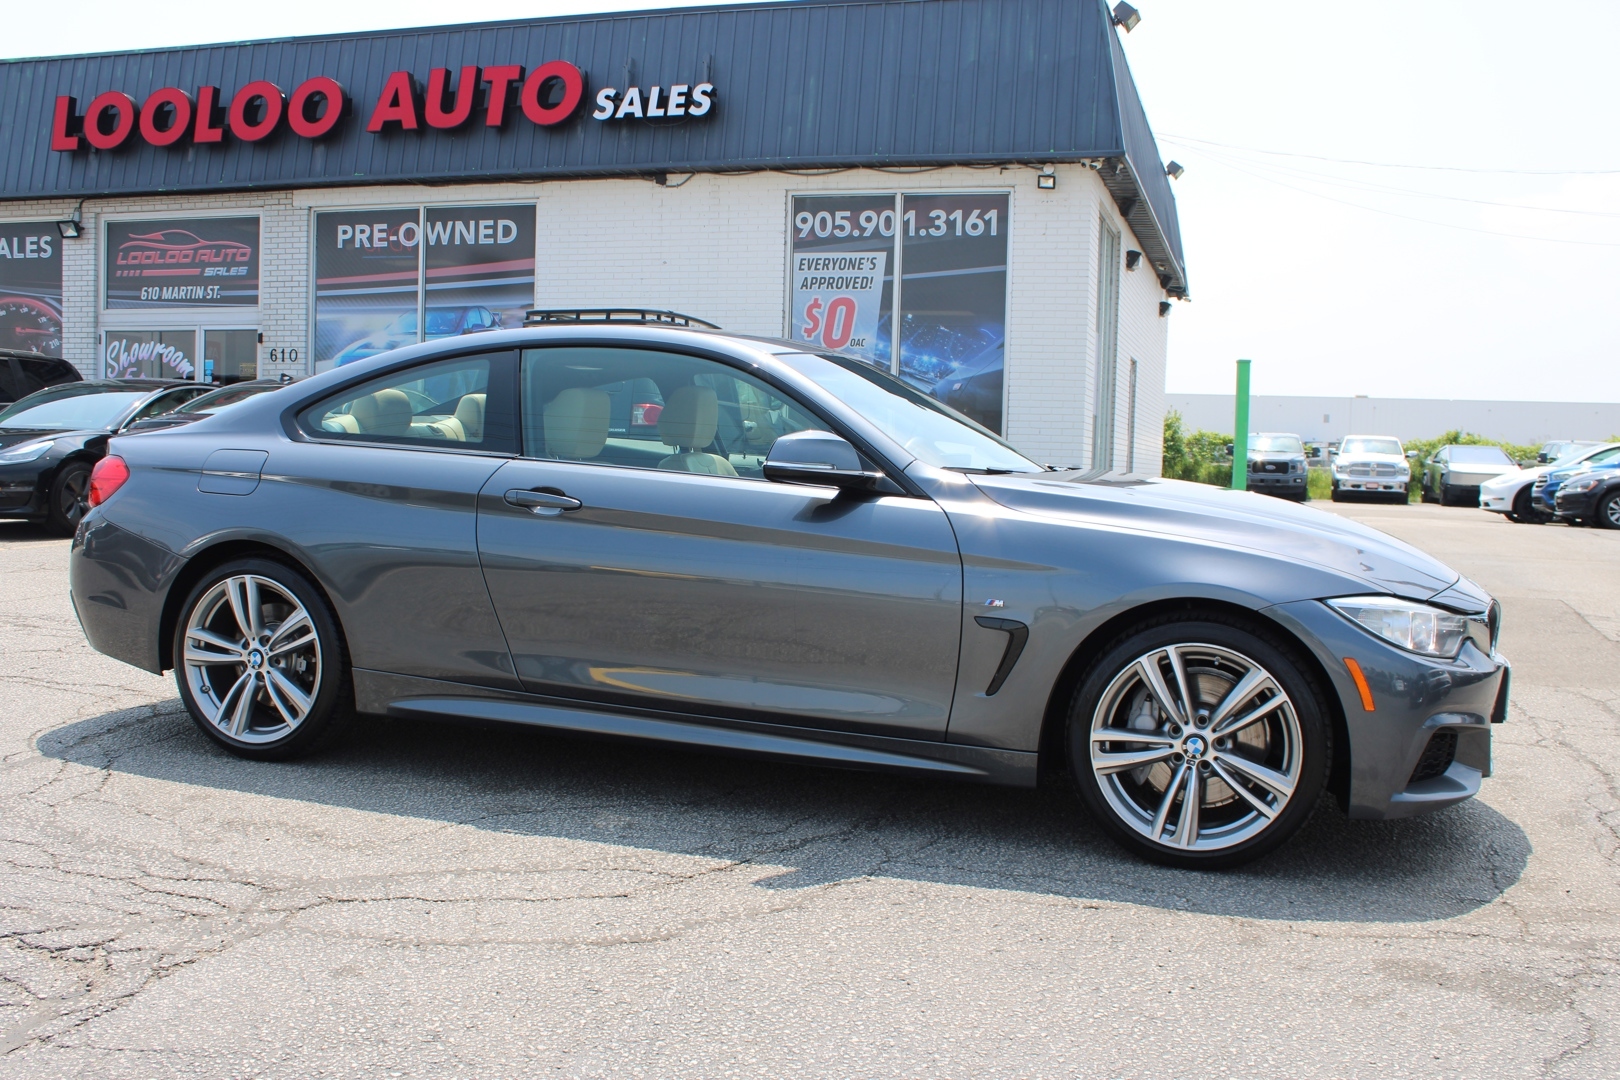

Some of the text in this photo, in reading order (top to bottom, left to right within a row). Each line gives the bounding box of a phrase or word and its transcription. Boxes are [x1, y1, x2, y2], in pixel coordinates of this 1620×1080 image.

[51, 59, 714, 151] LOOLOO AUTO SALES
[795, 208, 998, 238] 905.901.3161
[336, 218, 518, 249] PRE-OWNED
[116, 247, 252, 266] LOOLOO AUTO
[798, 256, 878, 272] EVERYONE'S
[204, 266, 249, 277] SALES
[800, 276, 874, 290] APPROVED!
[140, 285, 222, 301] 610 MARTIN ST.
[803, 296, 866, 349] $0 OAC
[106, 338, 196, 379] Showroom
[269, 347, 299, 363] 610
